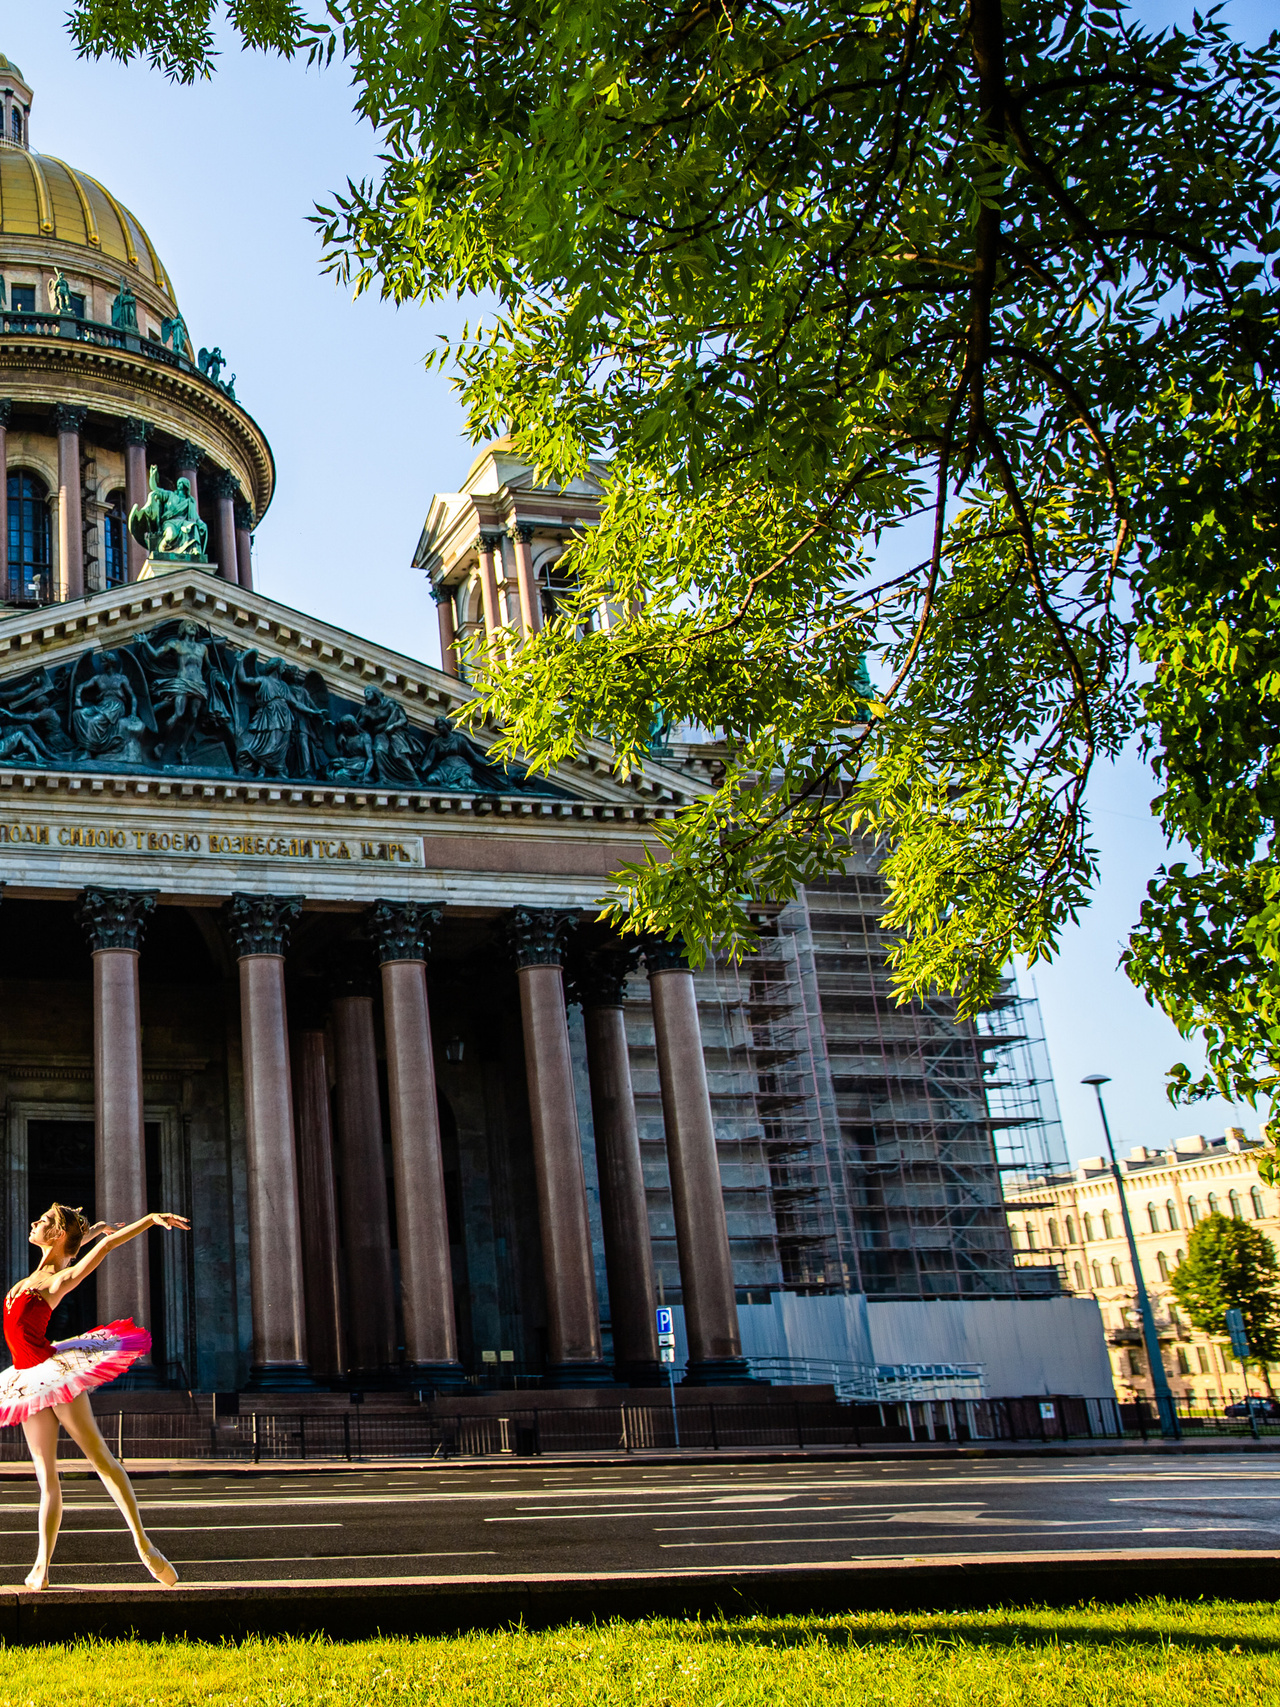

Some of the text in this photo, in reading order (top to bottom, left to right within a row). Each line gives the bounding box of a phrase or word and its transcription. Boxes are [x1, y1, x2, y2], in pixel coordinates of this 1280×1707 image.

[58, 827, 127, 848] СИЛОЮ
[131, 830, 202, 852] ТВОЕЮ
[660, 1311, 670, 1331] P
